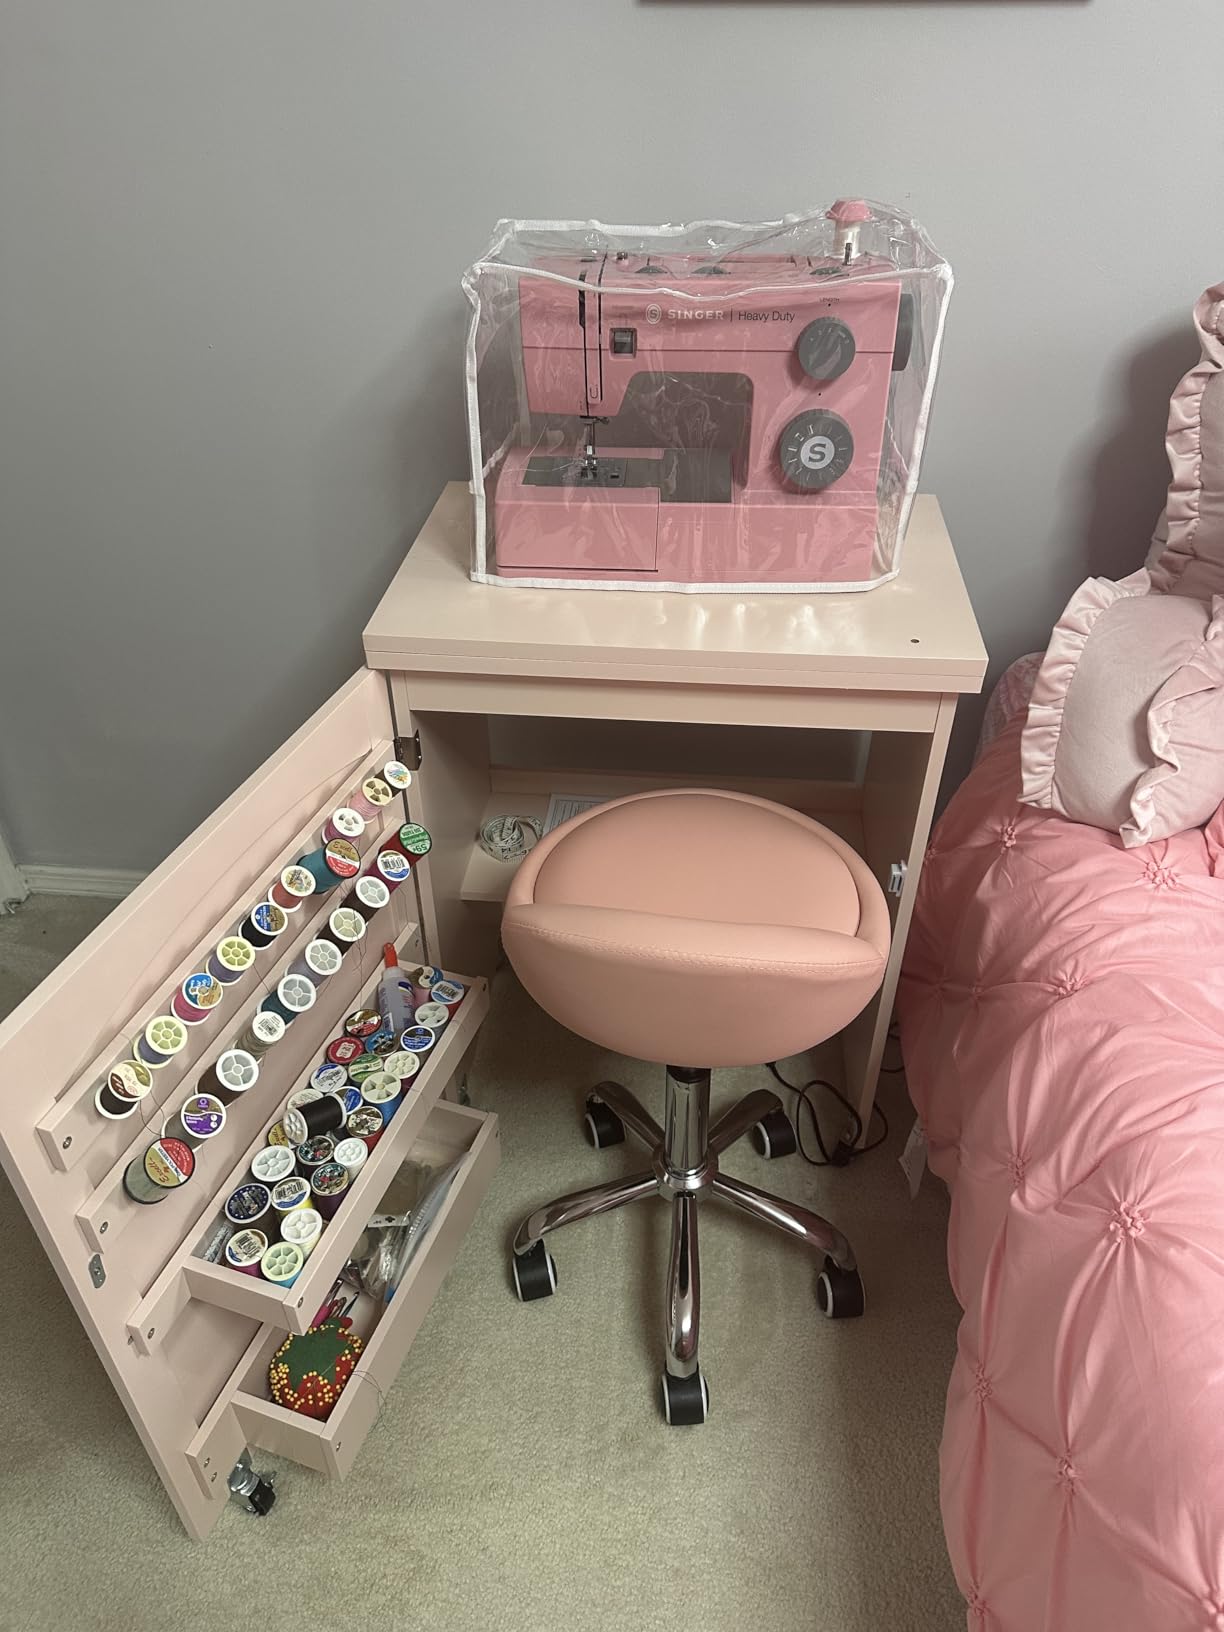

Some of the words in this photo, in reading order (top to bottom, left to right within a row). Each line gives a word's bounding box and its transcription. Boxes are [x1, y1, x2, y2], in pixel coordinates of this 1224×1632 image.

[667, 309, 725, 320] SINGER
[738, 311, 769, 323] Heavy
[772, 311, 796, 323] Duty
[808, 443, 827, 463] S
